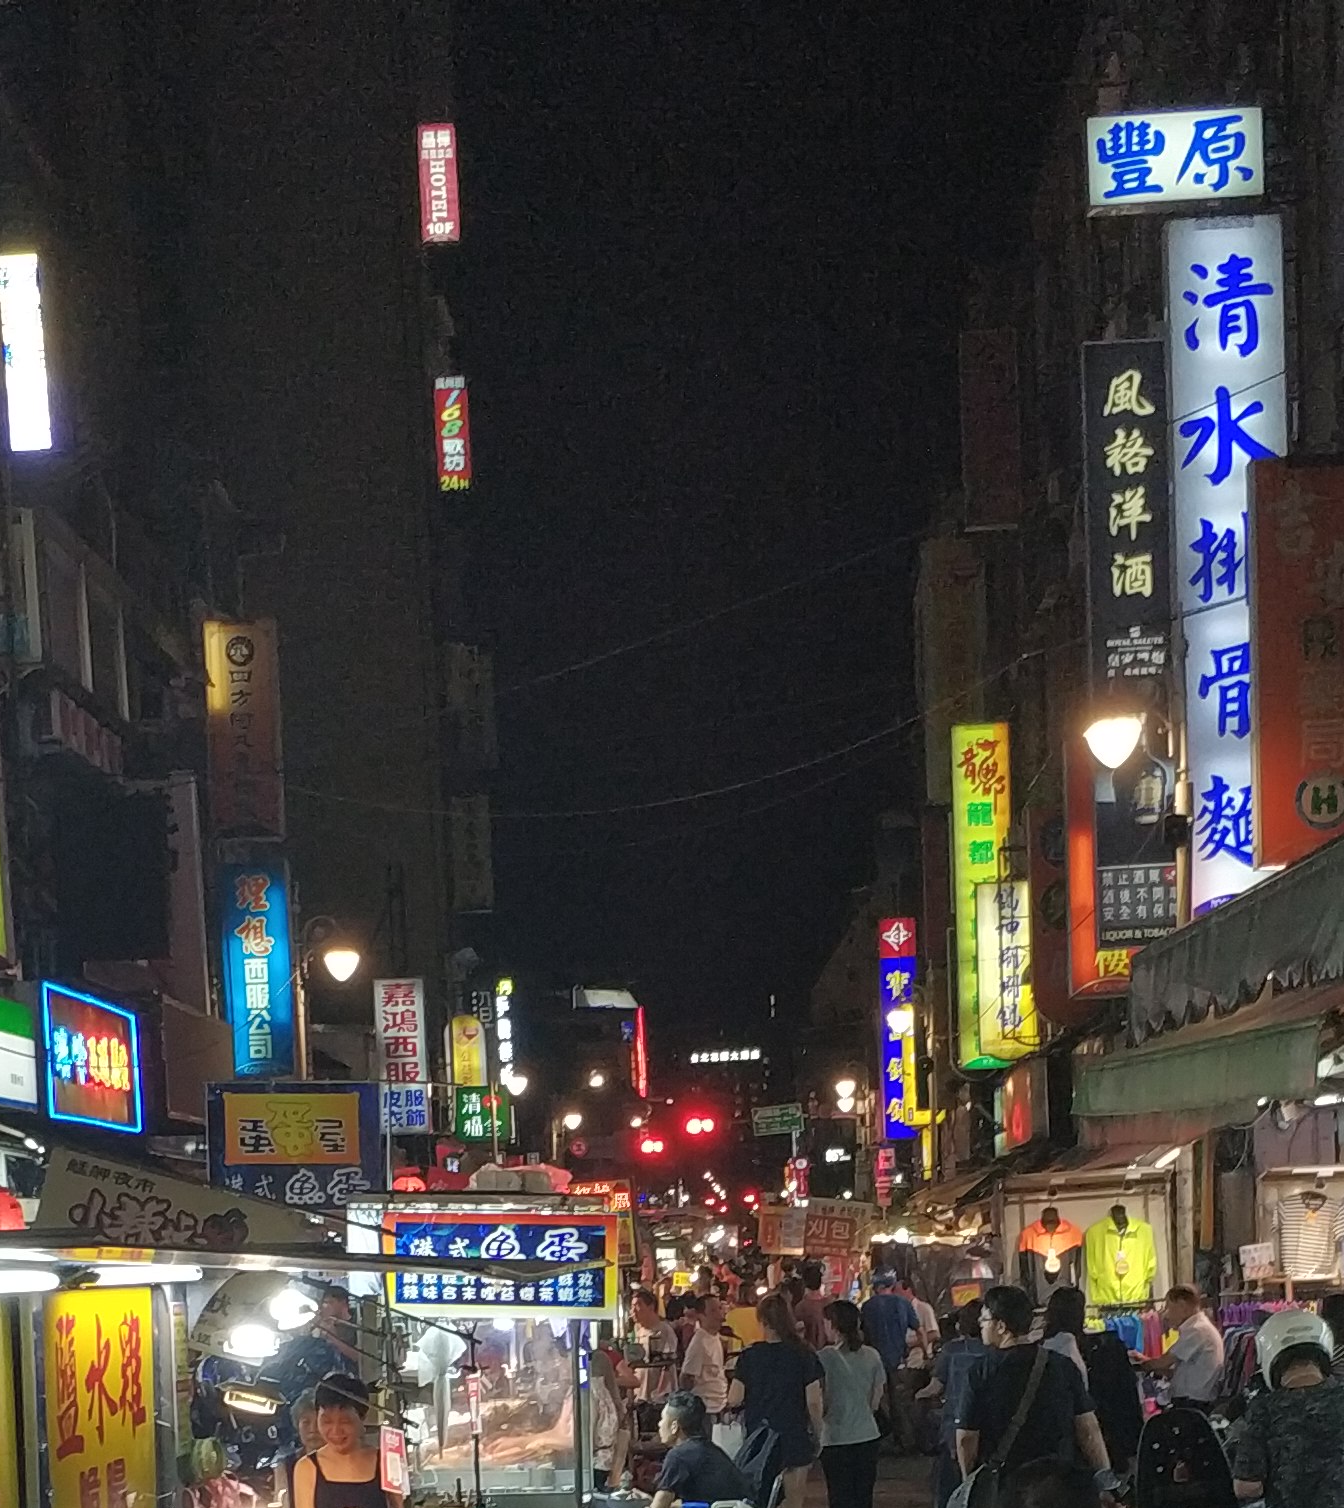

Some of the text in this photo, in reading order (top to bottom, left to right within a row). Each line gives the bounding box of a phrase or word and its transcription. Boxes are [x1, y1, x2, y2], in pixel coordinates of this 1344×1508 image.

[430, 159, 448, 222] HOTEL
[1097, 115, 1254, 199] 豐原
[1102, 368, 1155, 598] 風格洋酒
[234, 875, 275, 1059] 理想西服公司
[382, 983, 420, 1083] 嘉鴻西服
